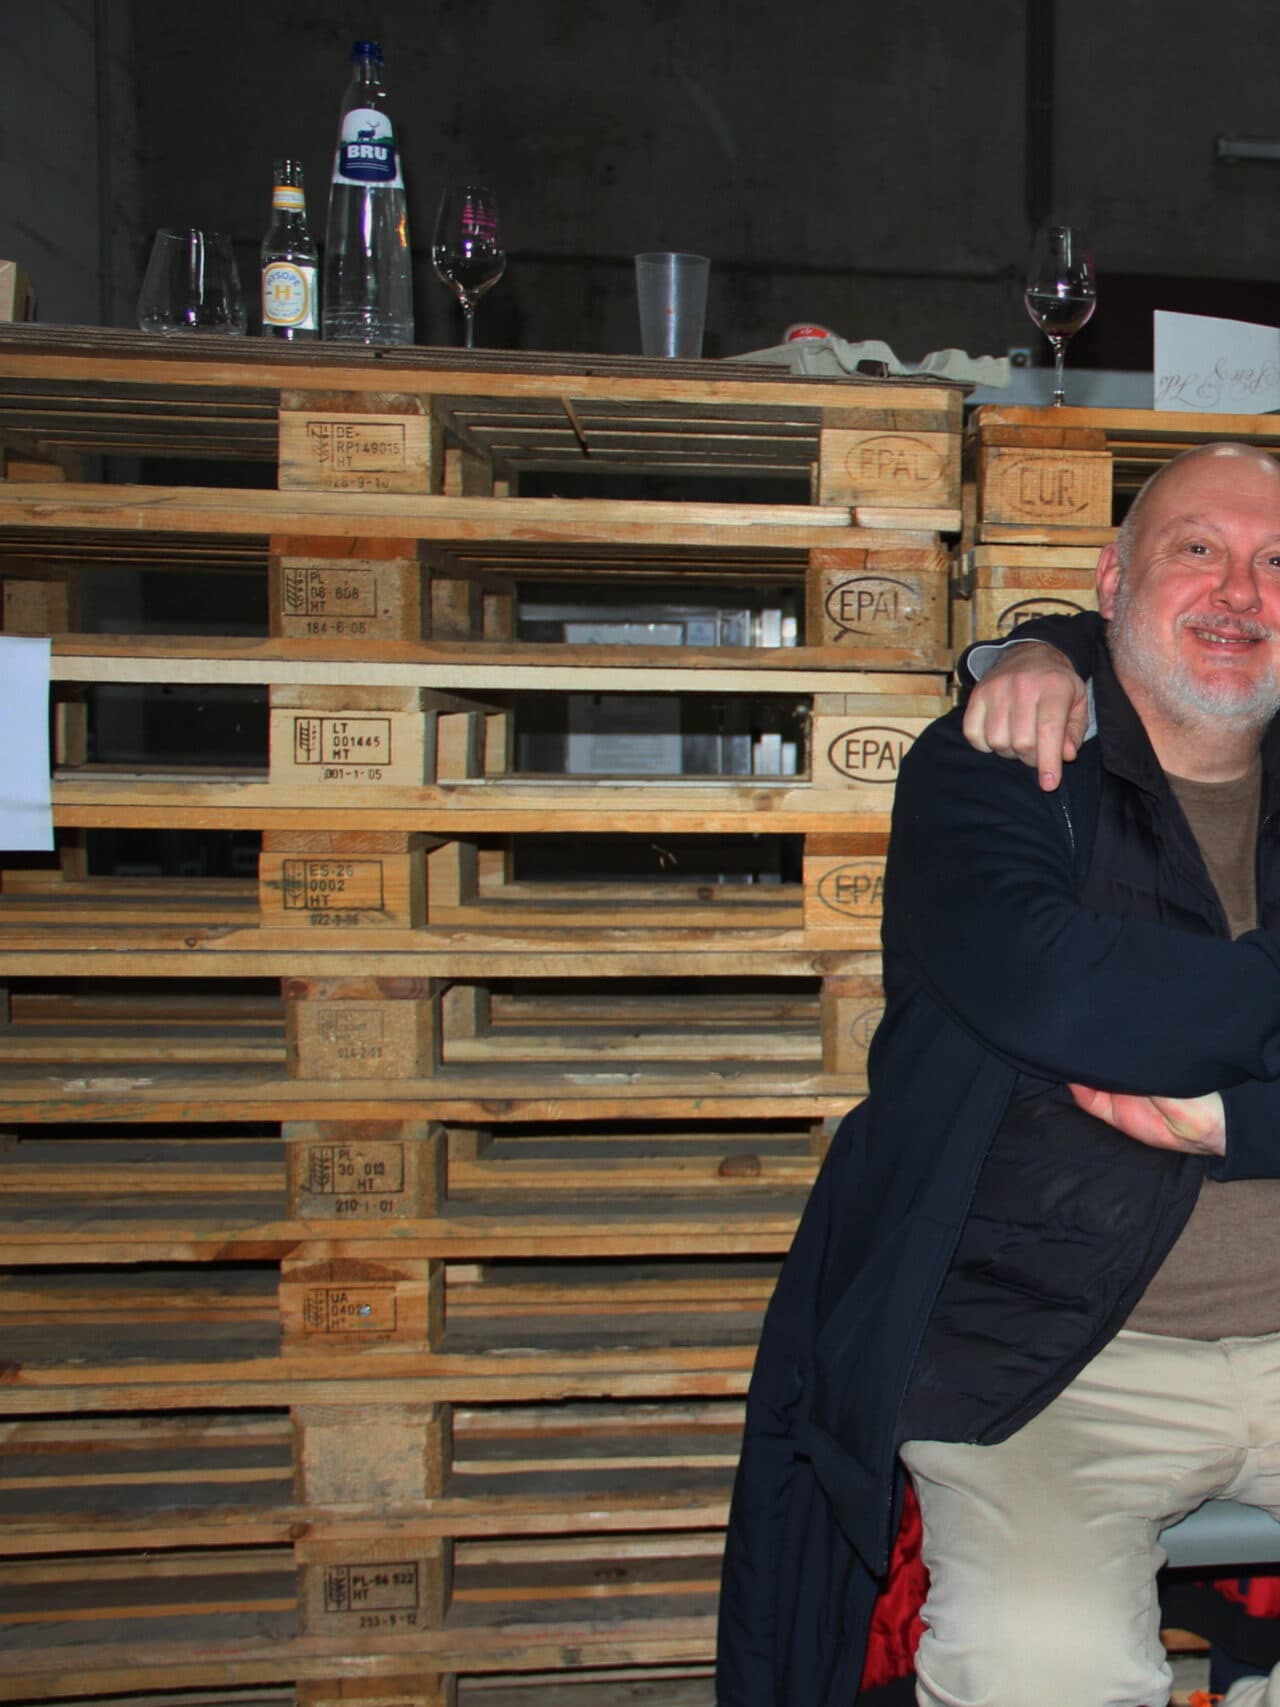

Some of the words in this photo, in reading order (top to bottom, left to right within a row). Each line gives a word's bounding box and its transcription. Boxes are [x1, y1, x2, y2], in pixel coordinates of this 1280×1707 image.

[347, 144, 388, 161] BRU
[274, 284, 291, 300] H
[861, 448, 929, 481] EPAL
[311, 602, 326, 612] HT
[333, 722, 349, 734] LT
[333, 736, 381, 748] 001445
[333, 749, 350, 761] HT
[310, 879, 345, 892] 0002
[836, 875, 884, 904] EPA
[310, 895, 330, 906] HT
[339, 1162, 355, 1176] 30
[358, 1178, 374, 1190] HT
[331, 1292, 348, 1304] UA
[352, 1588, 369, 1600] HT
